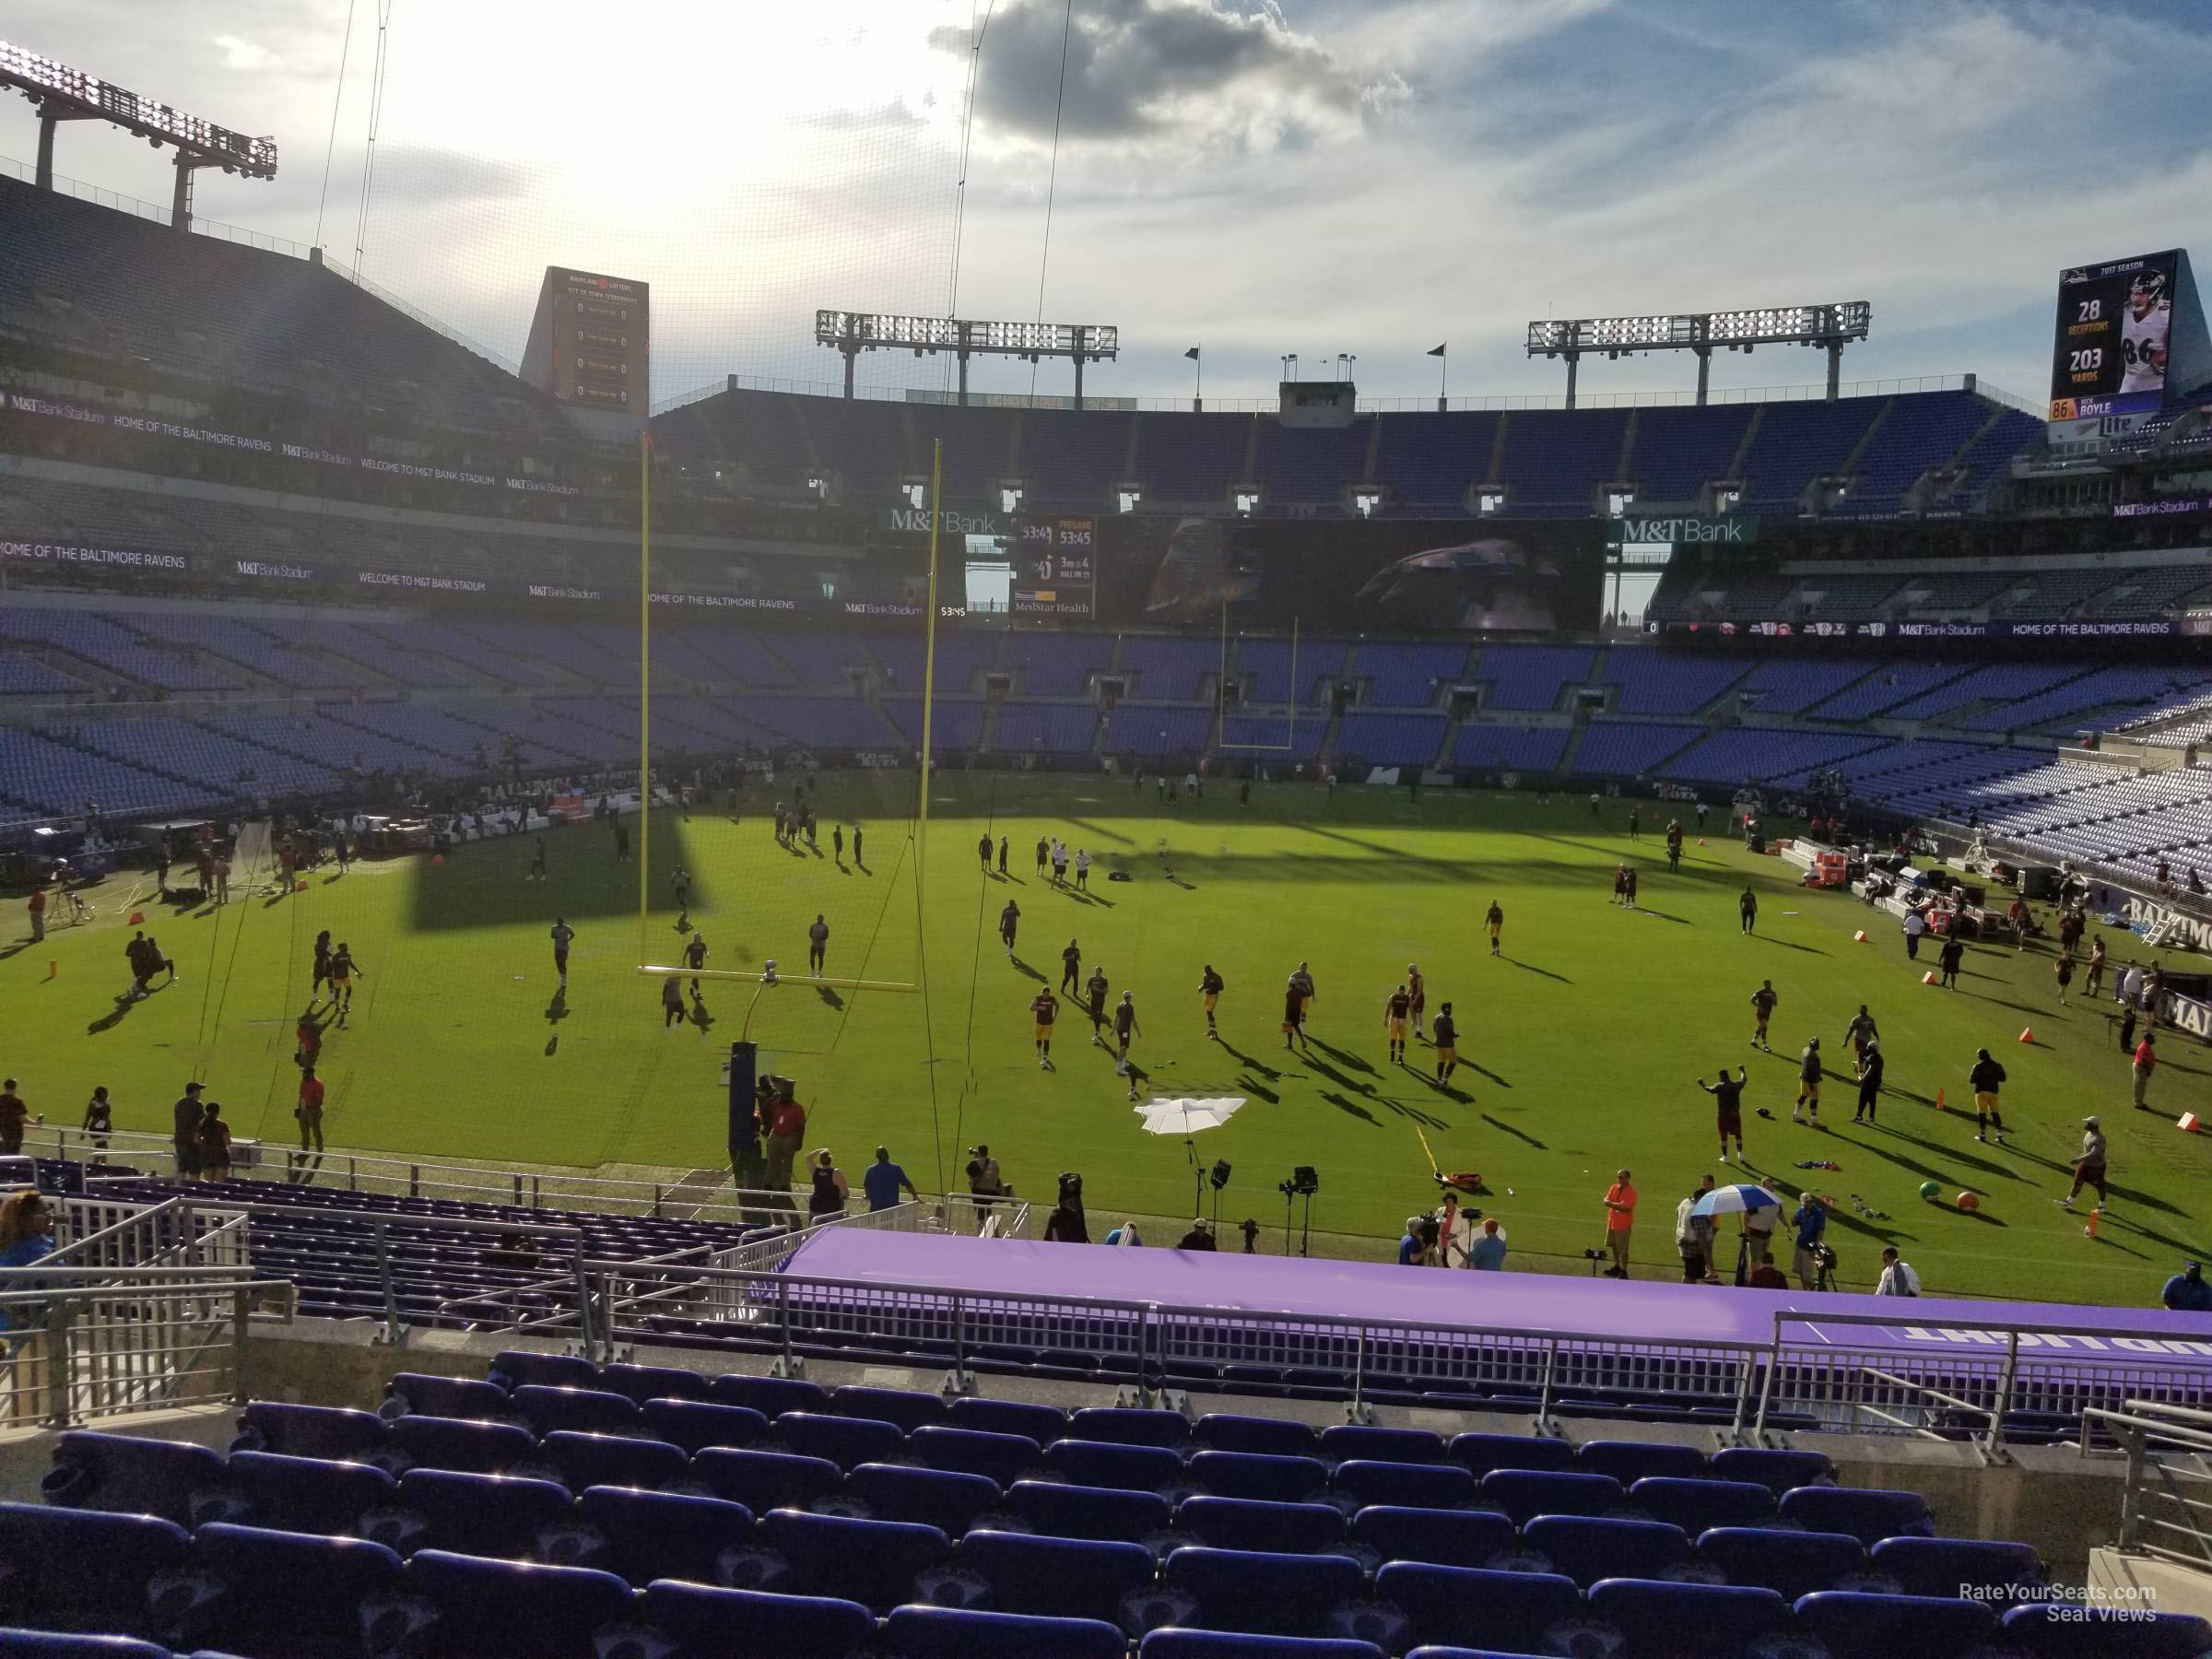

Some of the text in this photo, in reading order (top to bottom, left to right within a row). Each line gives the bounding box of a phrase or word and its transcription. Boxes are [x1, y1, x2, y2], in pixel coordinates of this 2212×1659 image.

[2100, 261, 2144, 276] 2017 SEASON
[2078, 300, 2100, 322] 28
[2068, 321, 2109, 335] RECEPTIONS
[2069, 348, 2102, 371] 203
[2072, 371, 2098, 383] YARDS
[11, 395, 37, 412] M&T
[2053, 401, 2068, 418] 86
[2080, 403, 2111, 416] BOYLE
[114, 416, 272, 452] HOME OF THE BALTIMORE RAVENS
[282, 443, 301, 457] M&T
[360, 457, 495, 485] WELCOME TO M&T BANK STADIUM
[506, 478, 526, 488] M&T
[2113, 505, 2137, 516] M&T
[947, 512, 995, 534] Bank
[1622, 519, 1742, 542] M&T Bank
[1060, 532, 1091, 545] 53:45
[34, 545, 51, 558] OF
[54, 546, 77, 559] THE
[80, 548, 142, 565] BALTIMORE
[144, 554, 185, 569] RAVENS
[237, 560, 259, 574] M&T
[359, 572, 486, 591] WELCOME TO M&T BANK STADIUM
[529, 584, 547, 595] M&T
[672, 594, 685, 604] OF
[687, 595, 704, 605] THE
[706, 596, 757, 607] BALTIMORE
[759, 599, 794, 609] RAVENS
[845, 603, 866, 613] M&T
[1016, 602, 1088, 613] MedStar Health
[941, 606, 966, 617] 53:45
[1650, 623, 1656, 632] 0
[1899, 624, 1984, 635] M&T Bank Stadium
[2013, 623, 2169, 634] HOME OF THE BALTIMORE RAVENS
